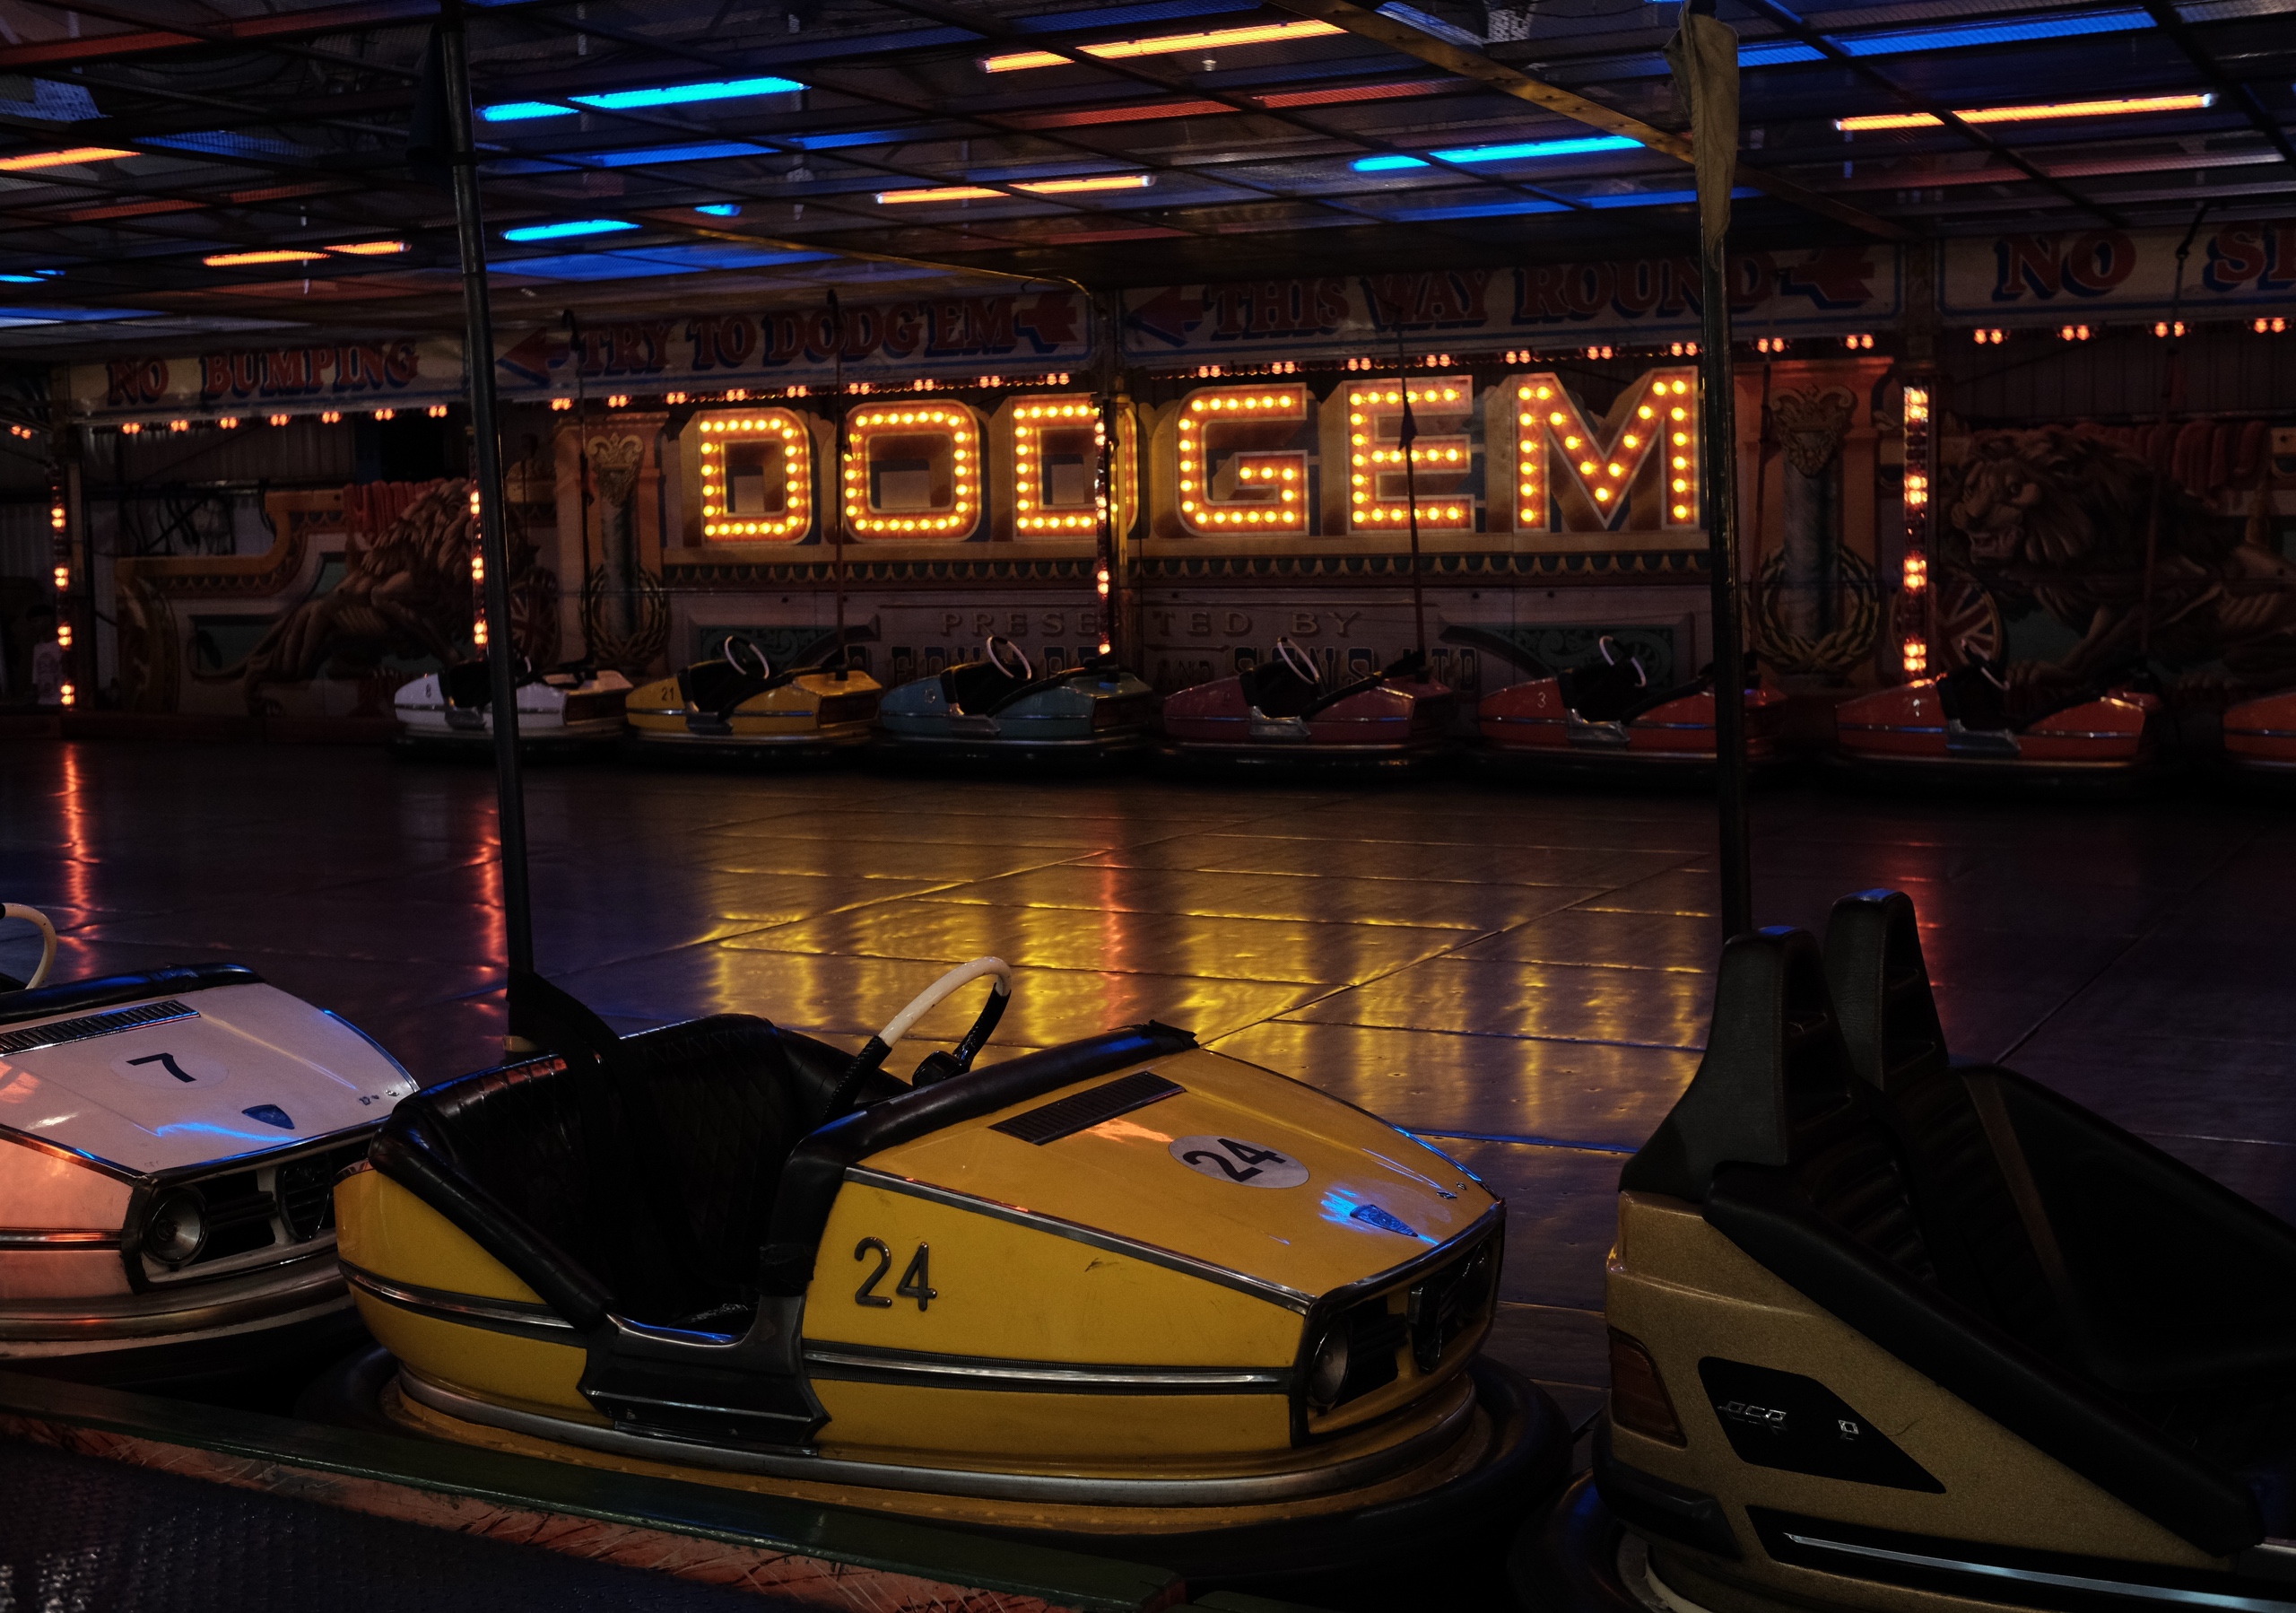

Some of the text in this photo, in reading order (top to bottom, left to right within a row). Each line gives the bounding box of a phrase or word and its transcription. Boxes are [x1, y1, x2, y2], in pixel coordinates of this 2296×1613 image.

[1992, 228, 2136, 302] NO
[1202, 248, 1777, 342] THIS WAY ROUND
[107, 338, 419, 405] NO BUMPING
[577, 319, 676, 377] TRY
[684, 314, 757, 371] TO
[694, 365, 1700, 546] DODGEM
[1290, 611, 1362, 638] BY
[661, 685, 674, 701] 21
[1401, 646, 1478, 692] TD
[1536, 691, 1547, 709] 3
[126, 1052, 196, 1083] 7
[1182, 1138, 1286, 1182] 24
[855, 1236, 938, 1312] 24
